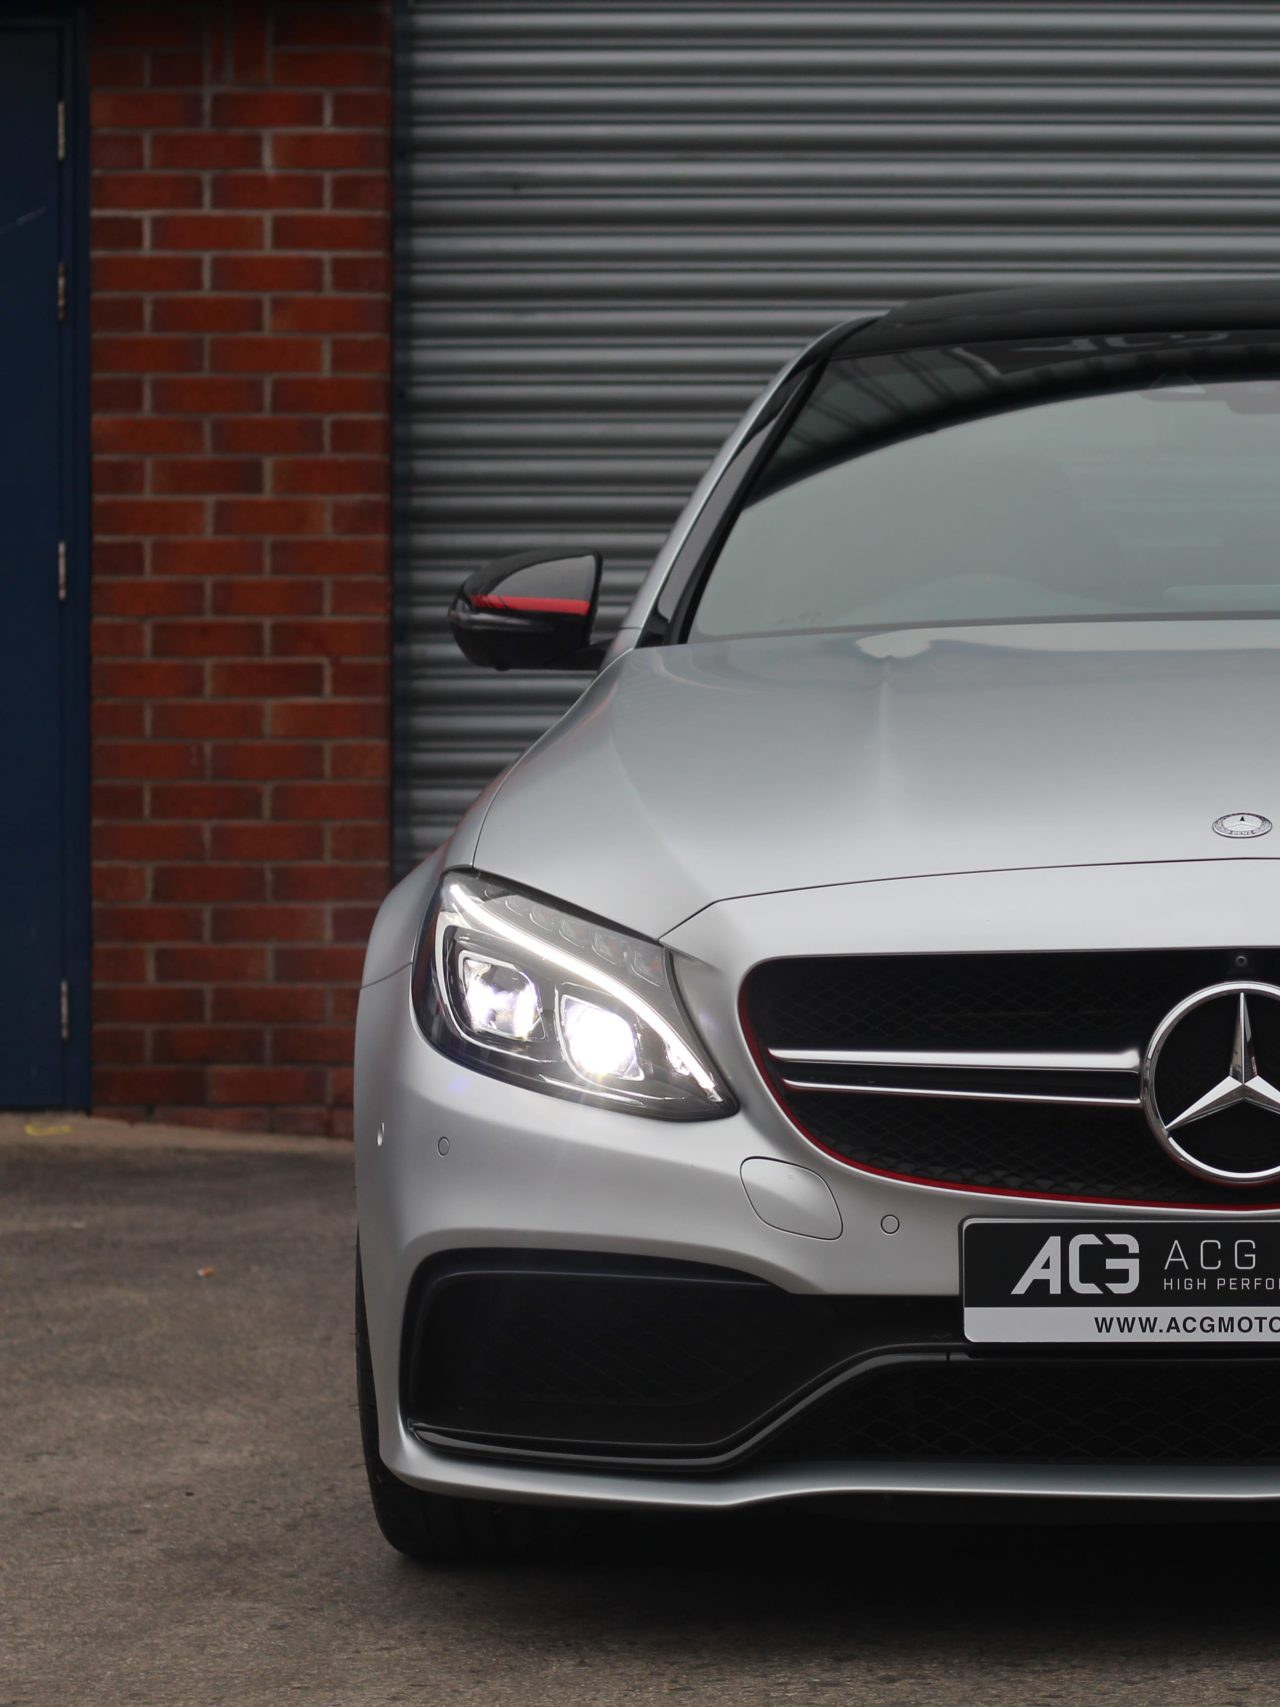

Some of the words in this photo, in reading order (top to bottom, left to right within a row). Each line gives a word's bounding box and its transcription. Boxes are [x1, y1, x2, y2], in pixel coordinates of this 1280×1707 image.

[1011, 1234, 1139, 1294] ACG
[1164, 1240, 1255, 1270] ACG
[1164, 1278, 1206, 1290] HIGH
